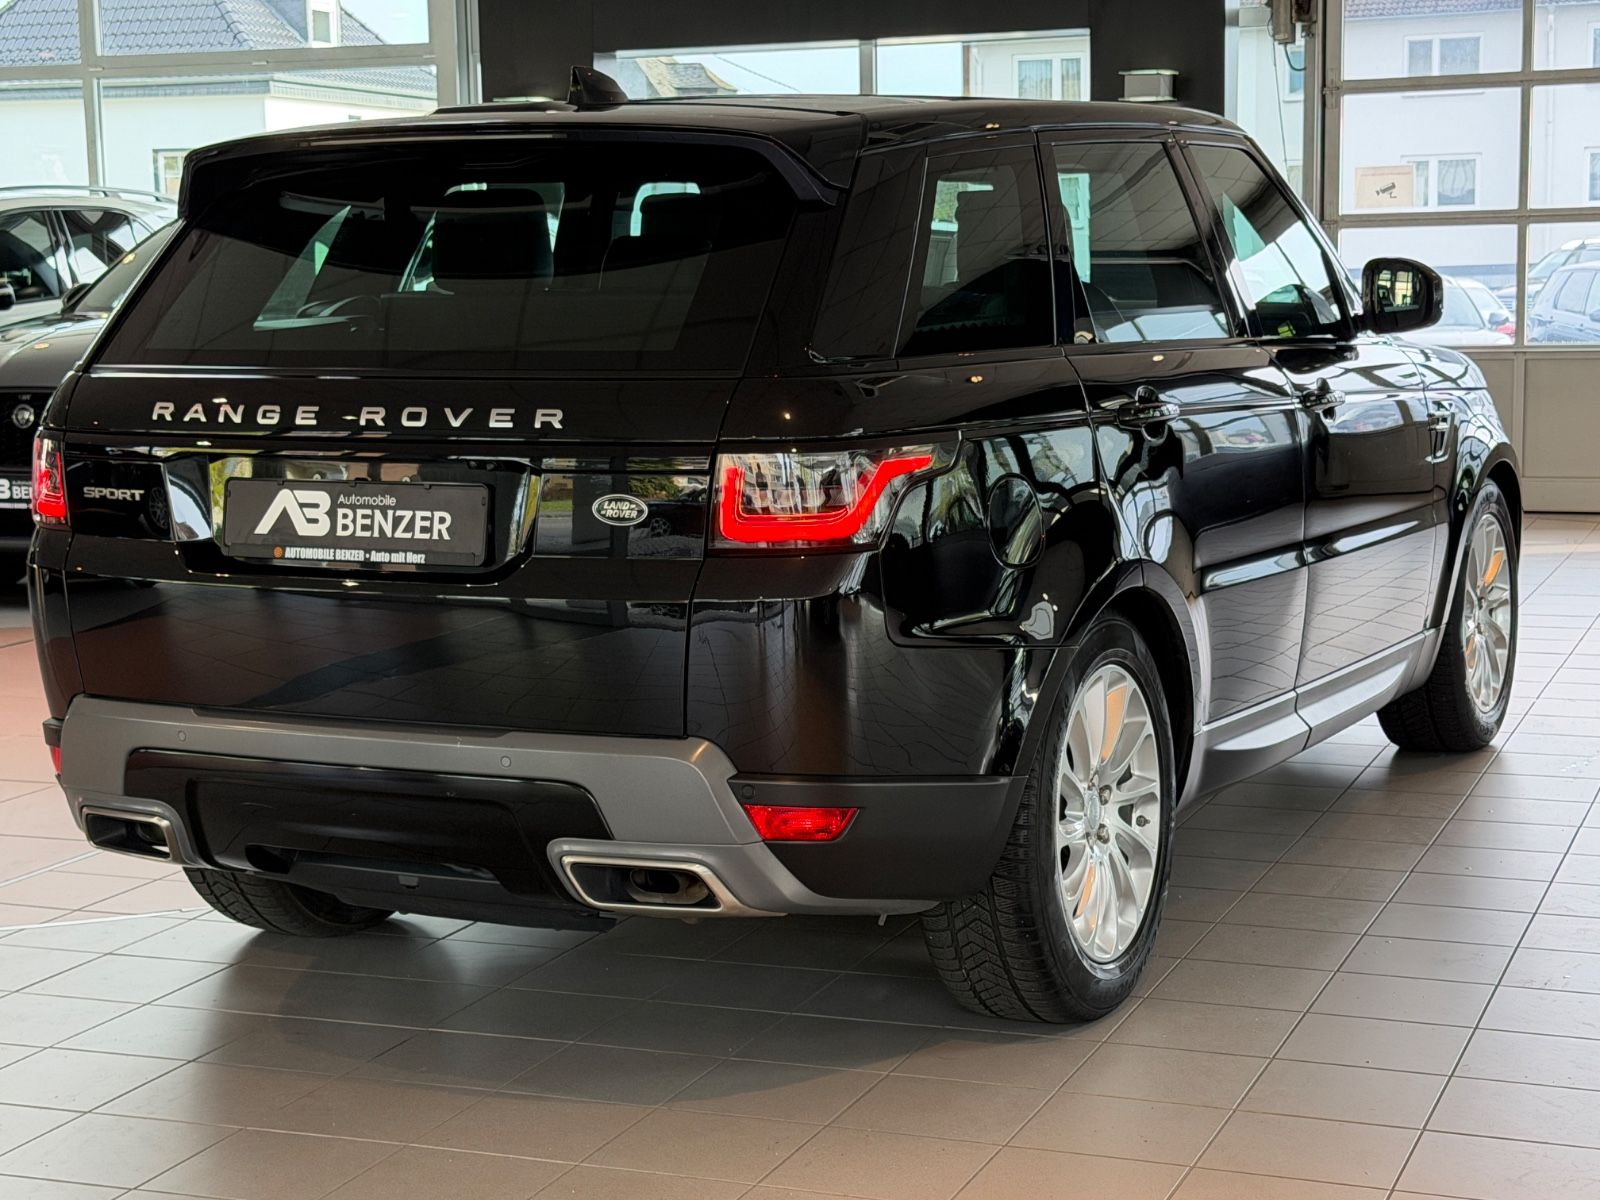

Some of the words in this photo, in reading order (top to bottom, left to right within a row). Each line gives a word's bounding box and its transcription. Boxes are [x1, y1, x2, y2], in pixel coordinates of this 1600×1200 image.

[151, 401, 320, 425] RANGE
[359, 406, 564, 429] ROVER
[83, 486, 145, 501] SPORT
[337, 493, 397, 506] Automobile
[336, 508, 452, 541] BENZER
[284, 546, 335, 560] AUTOMOBILE
[335, 549, 365, 562] BENZER
[370, 550, 392, 563] Auto
[391, 551, 405, 563] mit
[406, 551, 426, 564] Herz
